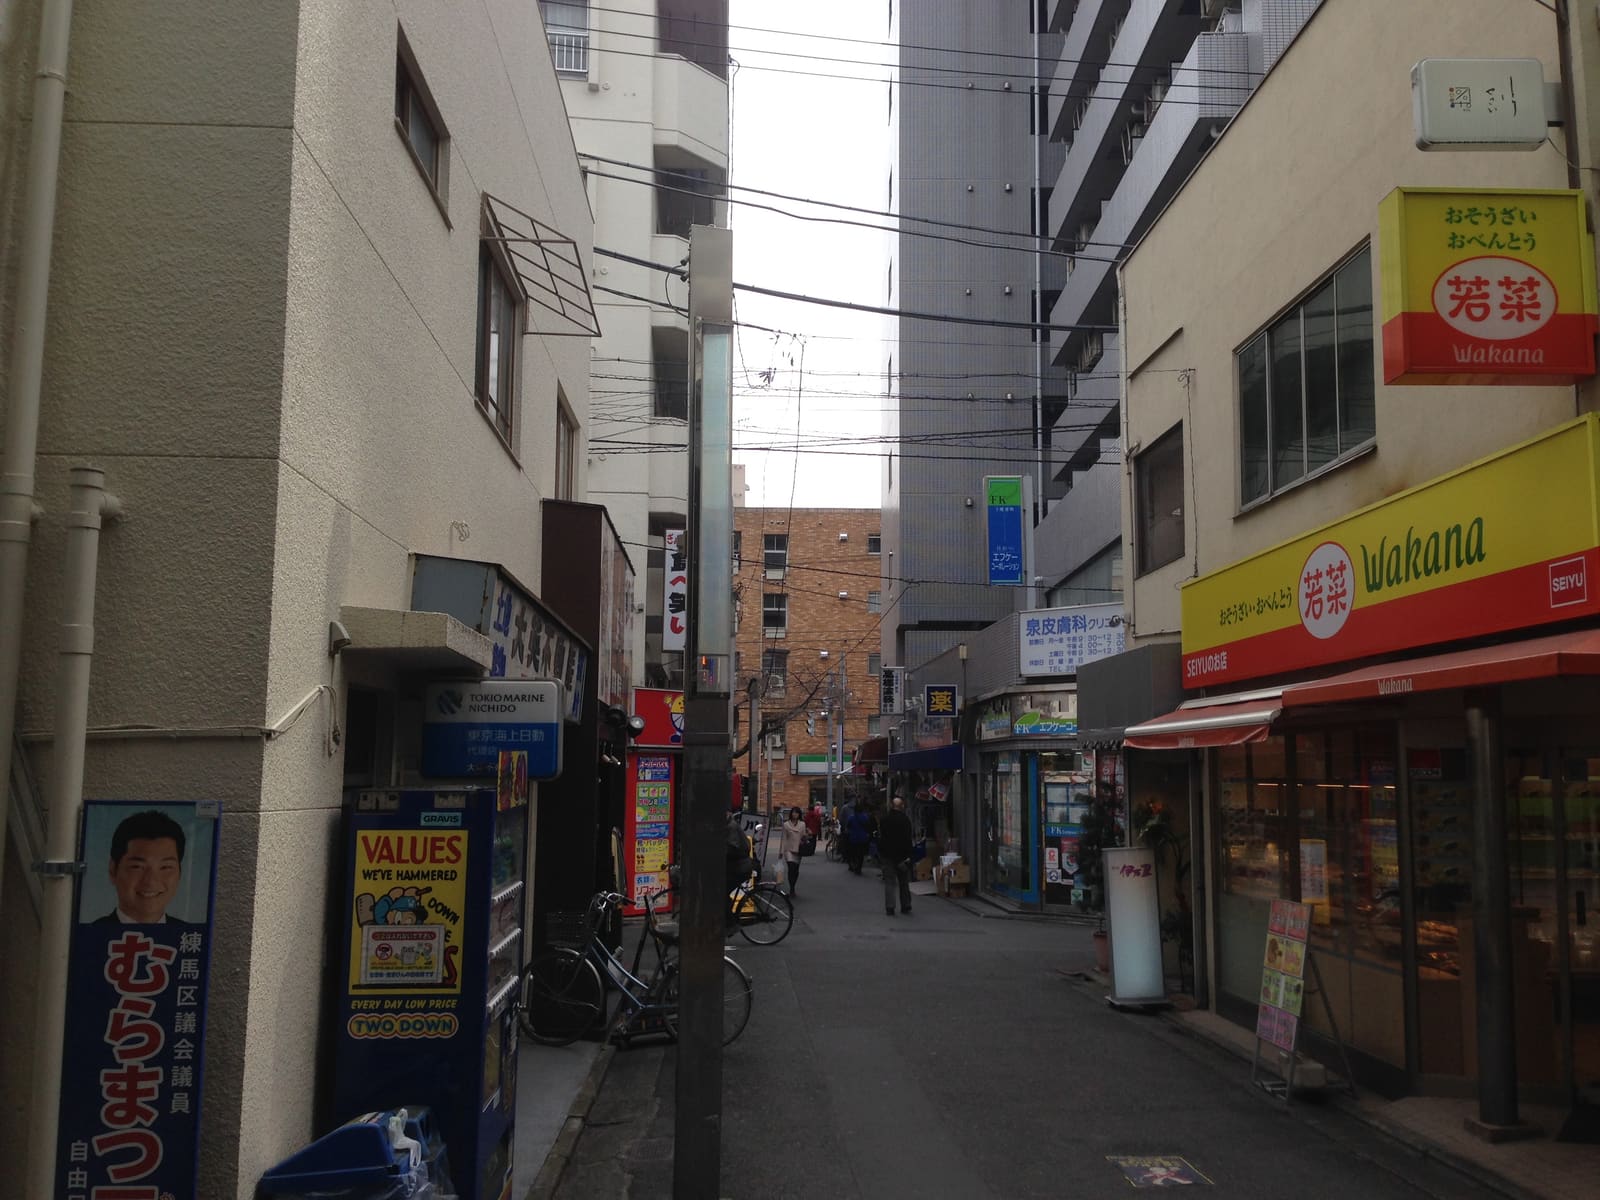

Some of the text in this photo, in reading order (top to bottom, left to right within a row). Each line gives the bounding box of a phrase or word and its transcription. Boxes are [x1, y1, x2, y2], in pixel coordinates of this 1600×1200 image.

[1445, 207, 1537, 226] おそうざい
[1447, 231, 1537, 251] おべんとう
[1446, 275, 1541, 322] 若菜
[1452, 344, 1545, 364] Wakana
[993, 553, 1019, 561] エフケー
[1360, 516, 1487, 593] Wakana
[1302, 559, 1348, 621] 若菜
[1551, 571, 1584, 592] SEIYU
[1186, 649, 1228, 678] SEIYUのお店
[1377, 677, 1414, 696] Wakana
[469, 693, 545, 703] TOKIO MARINE
[929, 690, 953, 713] 薬
[469, 704, 517, 713] NICHIDO
[467, 729, 545, 743] 東京海上日動
[423, 815, 460, 824] GRAVIS
[361, 835, 463, 865] VALUES
[362, 869, 458, 881] WE'VE HAMMERED
[427, 897, 460, 926] DOWN
[350, 999, 458, 1010] EVERY DAY LOW PRICE
[169, 931, 203, 1115] 練馬区議会議員
[354, 1019, 452, 1033] TWO DOWN
[91, 930, 178, 1200] むらまつ
